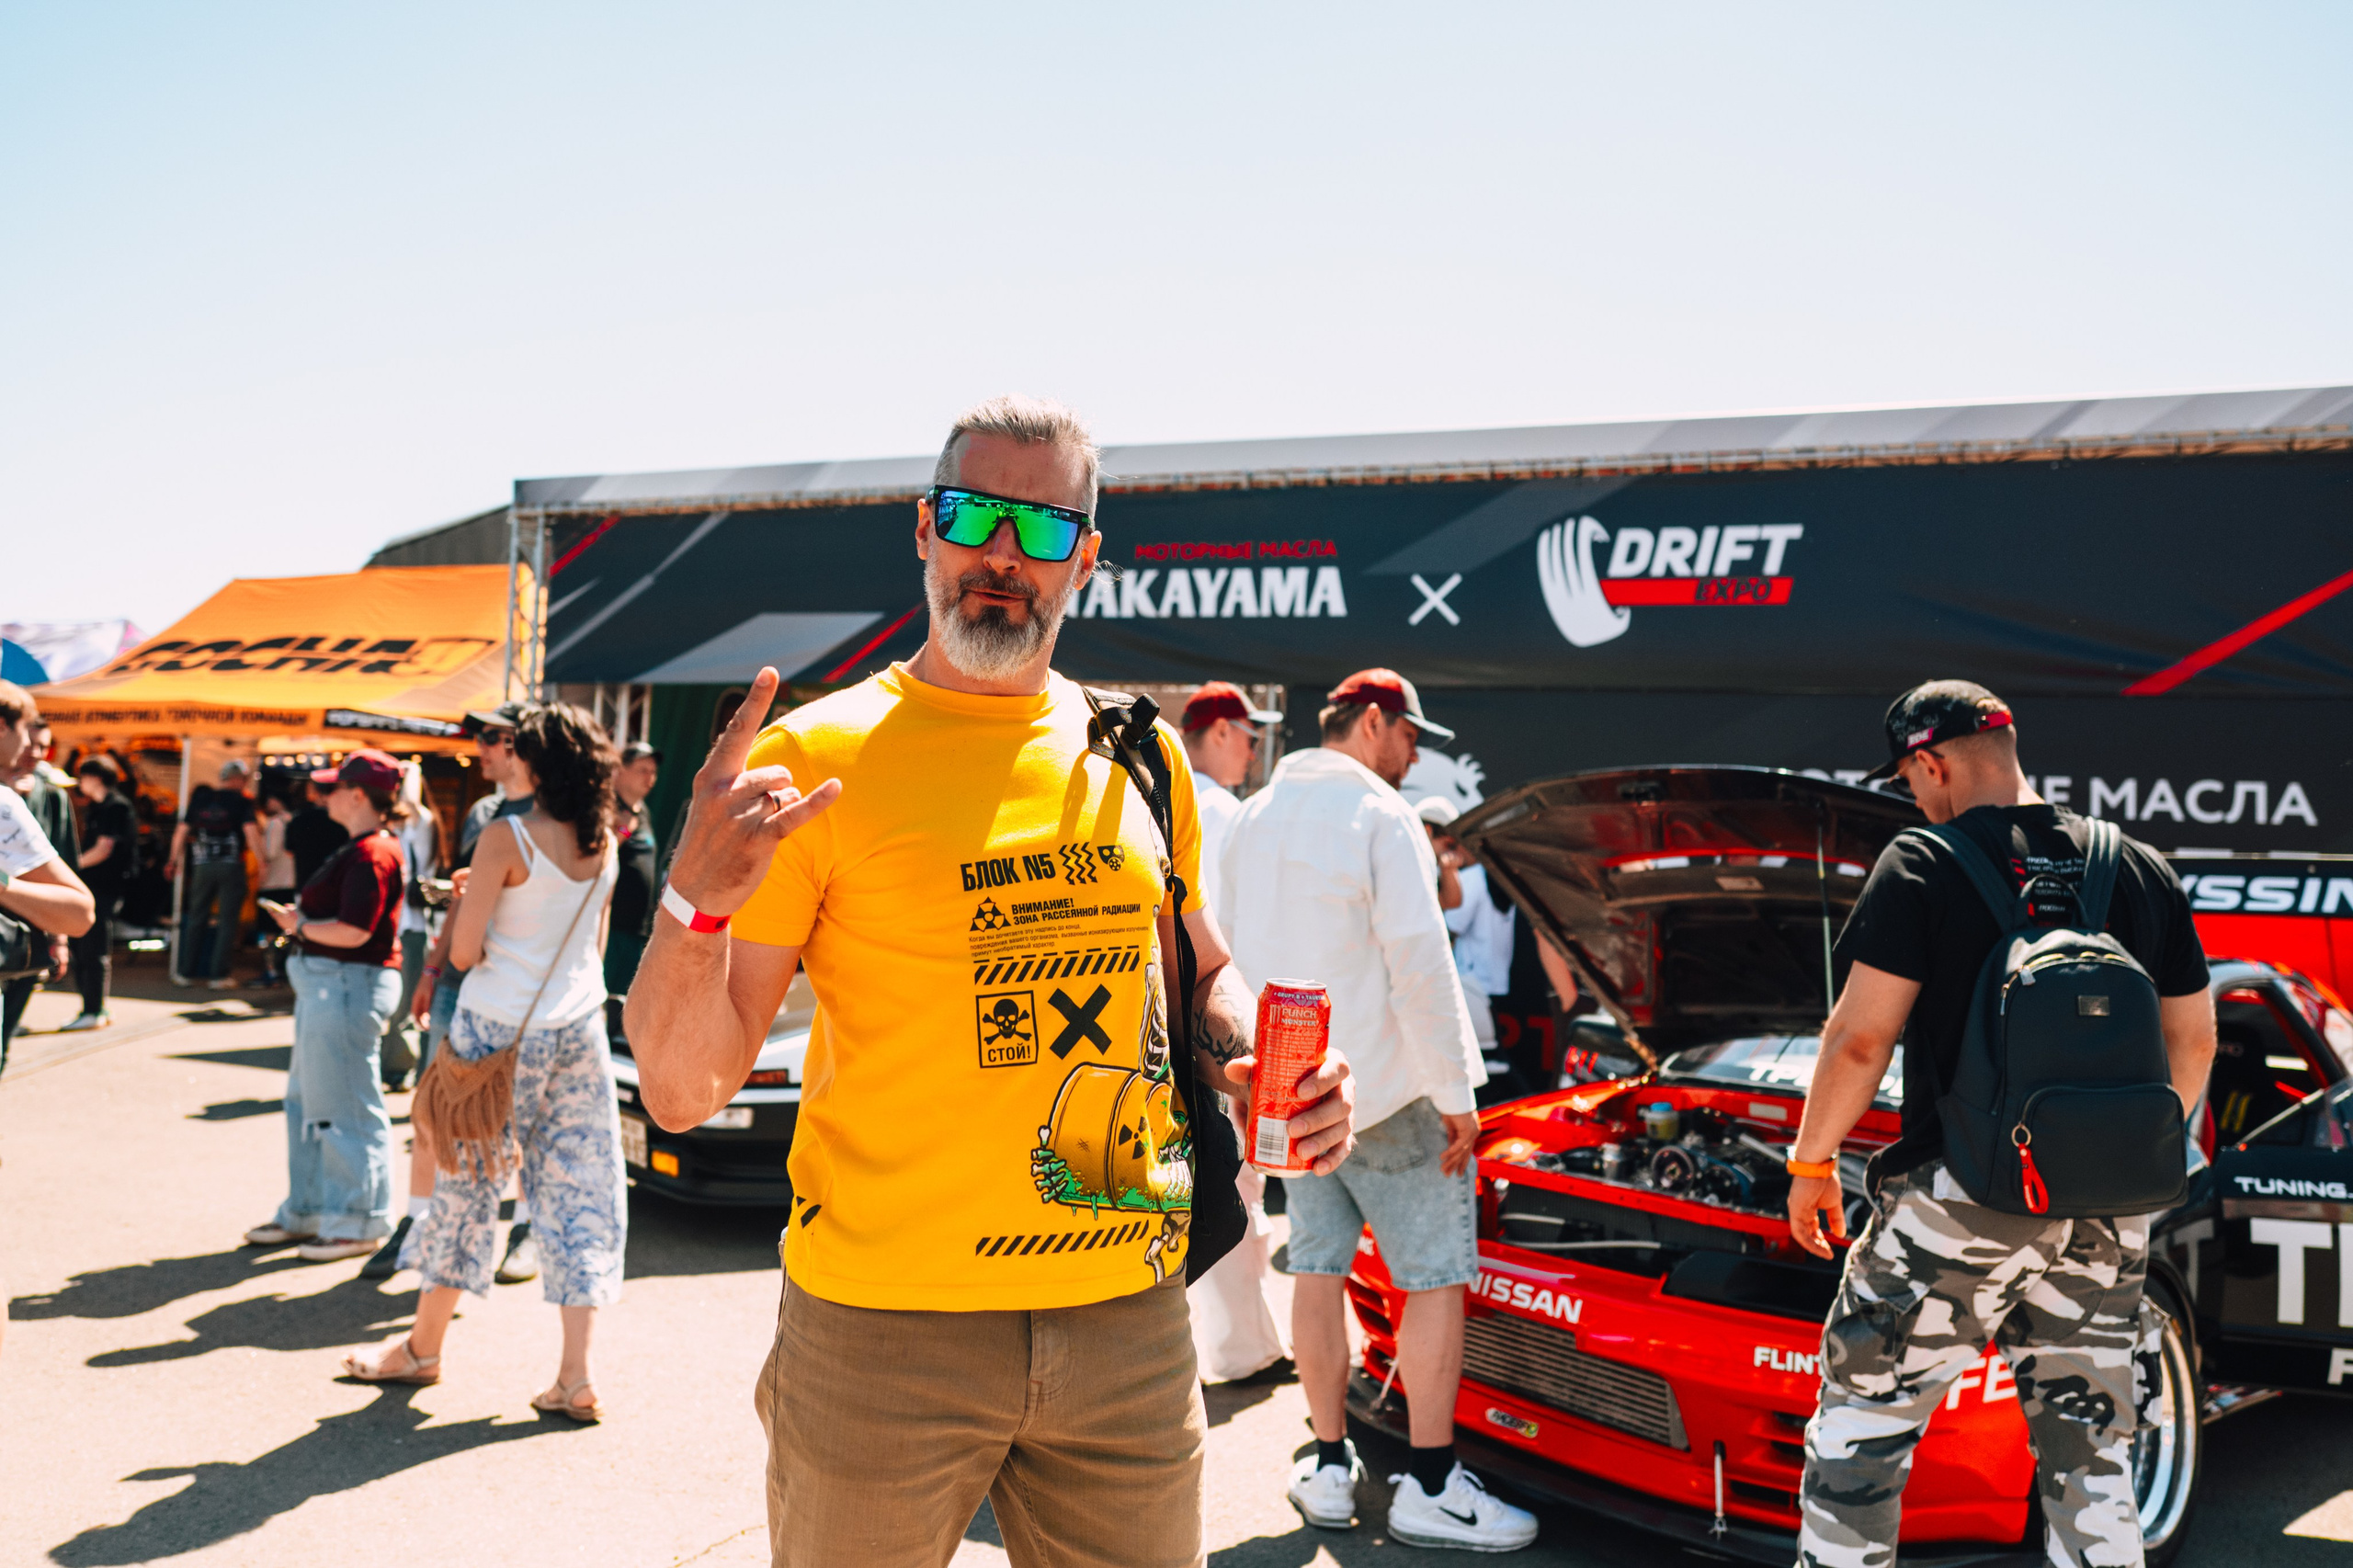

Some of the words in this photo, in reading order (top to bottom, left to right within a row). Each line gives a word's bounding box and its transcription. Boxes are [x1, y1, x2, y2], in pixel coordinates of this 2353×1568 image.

[1258, 540, 1337, 557] МАСЛА
[1607, 523, 1804, 577] DRIFT
[1695, 578, 1772, 601] EXPO
[2089, 778, 2318, 826] МАСЛА
[961, 858, 1021, 892] БЛОК
[1022, 853, 1057, 881] N5
[1011, 897, 1074, 915] ВНИМАНИЕ!
[1013, 914, 1040, 926] ЗОНА
[1041, 905, 1099, 922] РАССЕЯННОЙ
[1101, 903, 1142, 916] РАДИАЦИИ
[970, 939, 1007, 950] повреждения
[1009, 936, 1029, 944] вашего
[995, 930, 1024, 939] дочитаете
[971, 949, 992, 958] примут
[994, 943, 1031, 953] необратимый
[1281, 1007, 1317, 1019] PUNCH
[987, 1042, 1031, 1062] СТОЙ!
[1467, 1271, 1584, 1324] NISSAN
